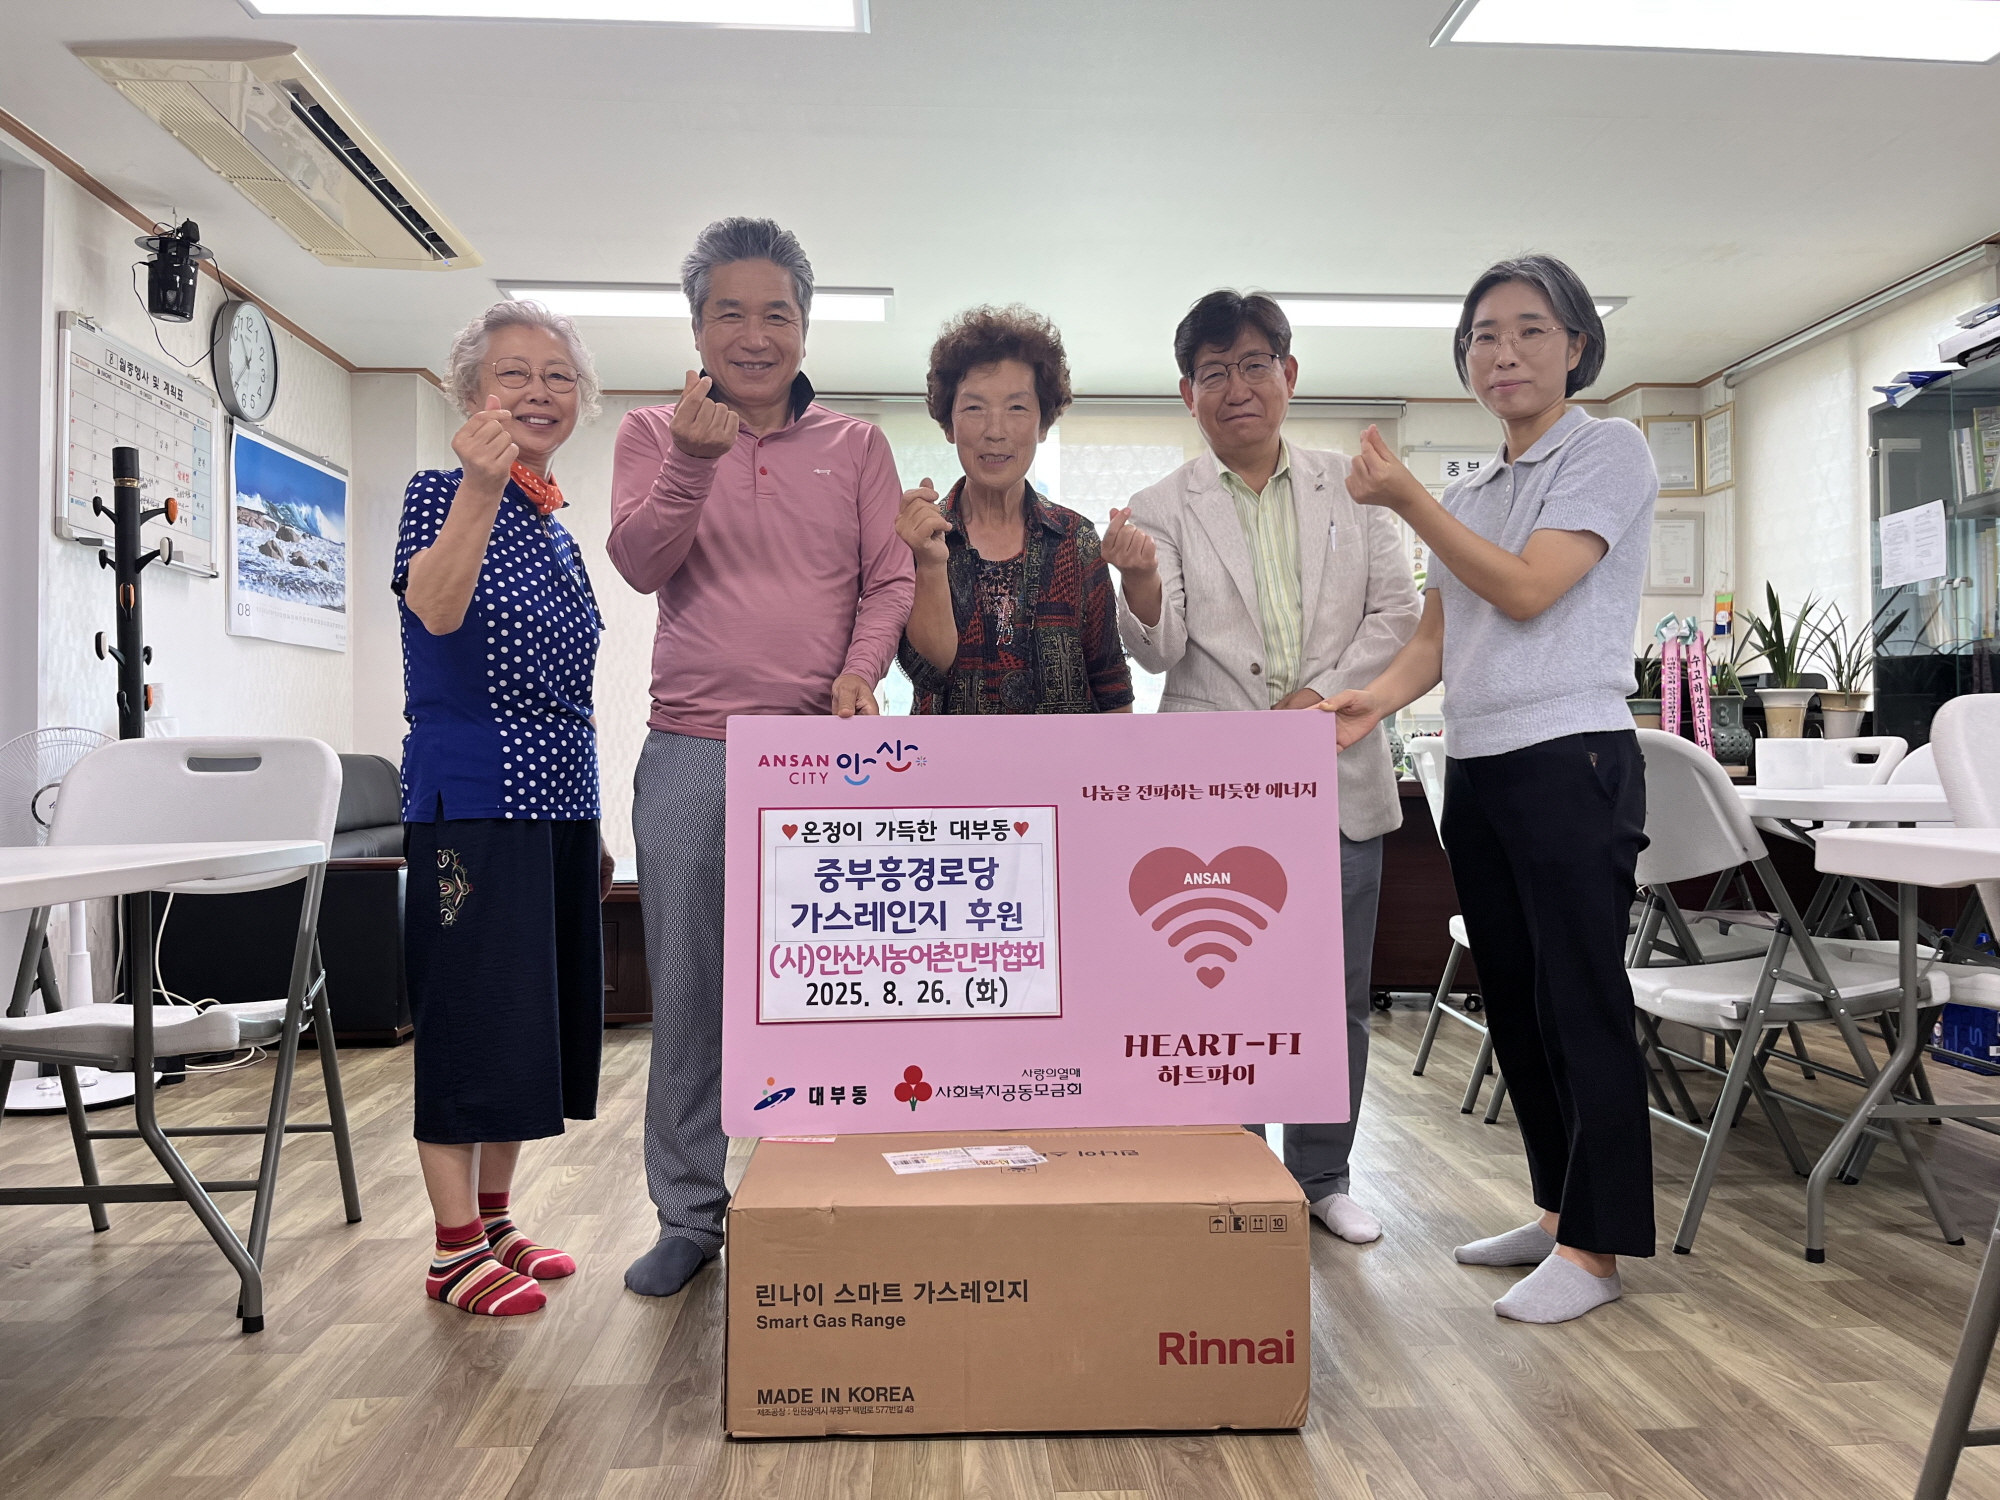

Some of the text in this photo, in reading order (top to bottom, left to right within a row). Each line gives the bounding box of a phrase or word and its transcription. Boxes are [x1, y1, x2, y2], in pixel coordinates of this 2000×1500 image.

[119, 357, 149, 385] 월중행사
[152, 375, 160, 390] 및
[163, 381, 184, 403] 계획표
[242, 394, 256, 409] 6 5
[237, 603, 251, 617] 08
[1691, 655, 1710, 750] 수고하셨습니다
[758, 754, 829, 767] ANSAN
[789, 772, 829, 785] CITY
[1082, 781, 1317, 801] 나눔을 전파하는 따듯한 에너지
[801, 820, 1011, 843] 온정이 가득한 대부동
[814, 856, 999, 893] 중부흥경로당
[1183, 872, 1231, 885] ANSAN
[790, 898, 1023, 933] 가스레인지 후원
[769, 941, 1045, 978] (사)안산시농어촌민박협회
[806, 977, 1008, 1008] 2025. 8. 26. (화)
[1124, 1033, 1301, 1058] HEART-FI
[1021, 1067, 1081, 1081] 사랑의열매
[1157, 1064, 1255, 1086] 하트파이
[808, 1085, 868, 1106] 대부동
[935, 1082, 1082, 1102] 사회복지공동모금회
[756, 1279, 1028, 1306] 린나이 스마트 가스레인지
[756, 1312, 906, 1330] Smart Gas Range
[1159, 1329, 1295, 1365] Rinnai
[757, 1386, 915, 1405] MADE IN KOREA
[793, 1407, 828, 1416] 인천광역시
[829, 1406, 851, 1416] 부평구
[876, 1405, 903, 1415] 577번길
